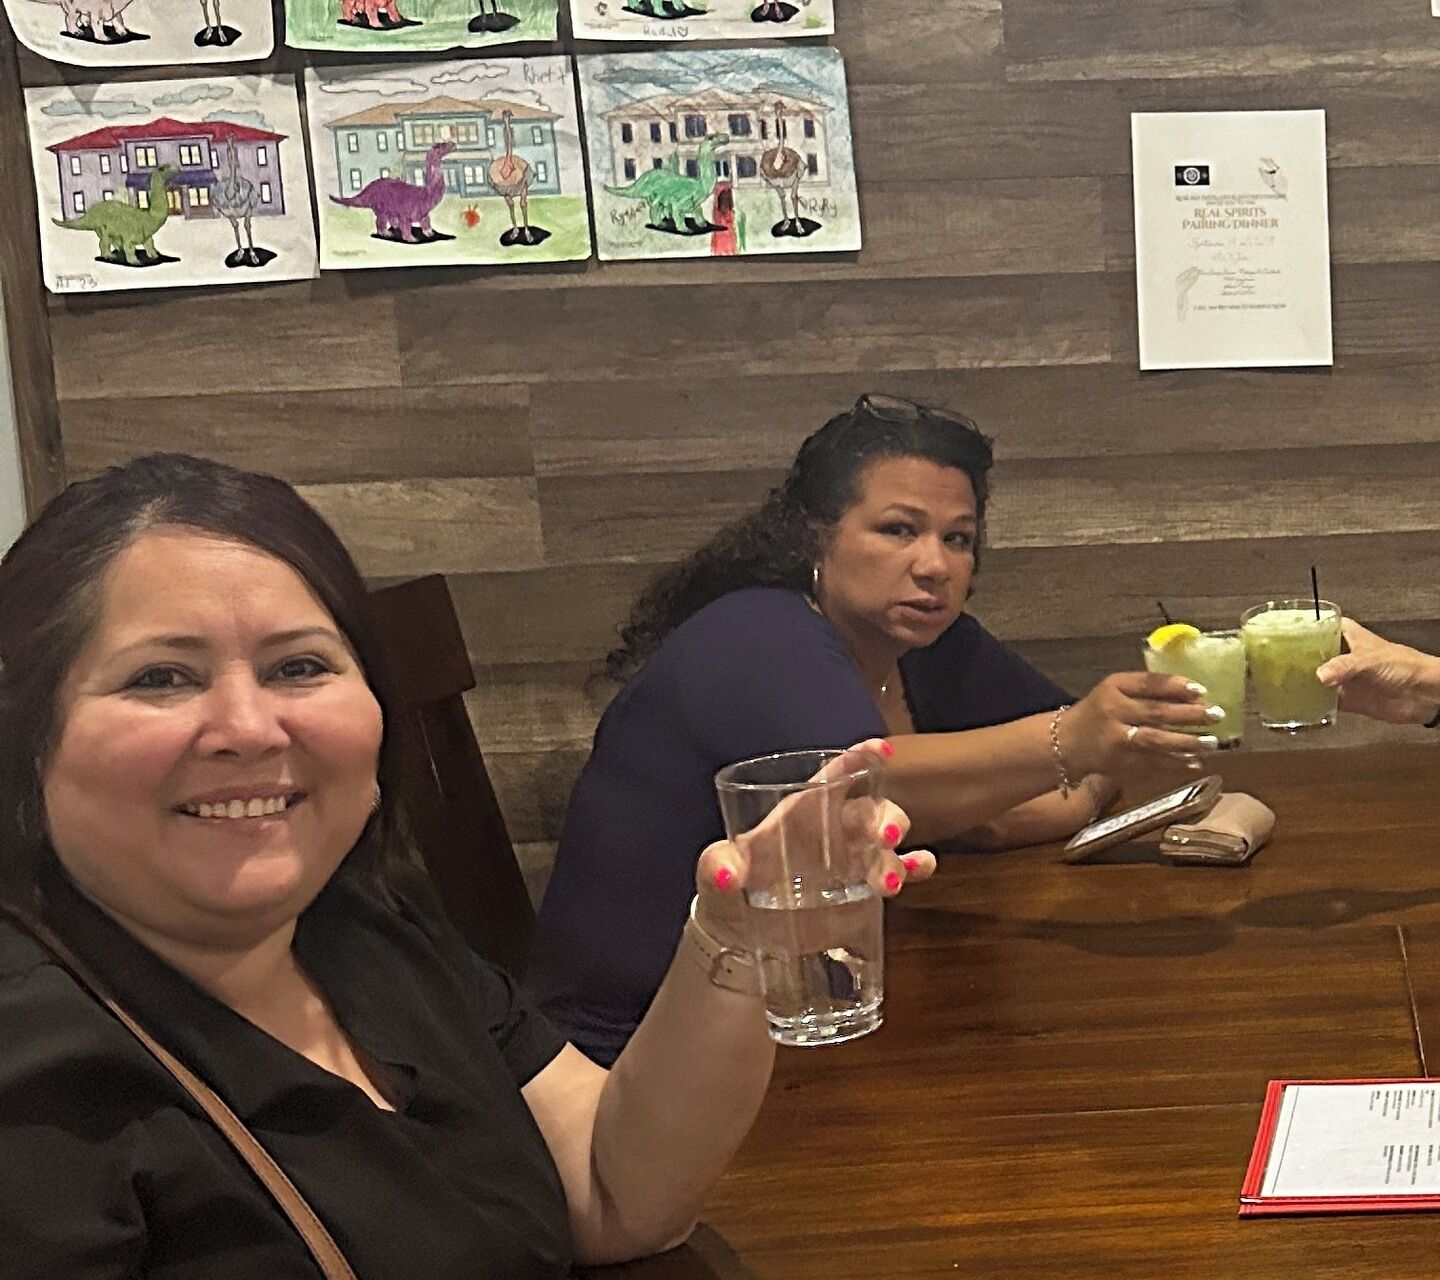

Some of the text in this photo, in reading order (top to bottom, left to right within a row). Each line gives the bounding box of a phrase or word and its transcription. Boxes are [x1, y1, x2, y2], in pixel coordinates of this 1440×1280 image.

[1194, 207, 1266, 218] REAL SPIRITS
[1182, 219, 1279, 230] PAIRING DINNER
